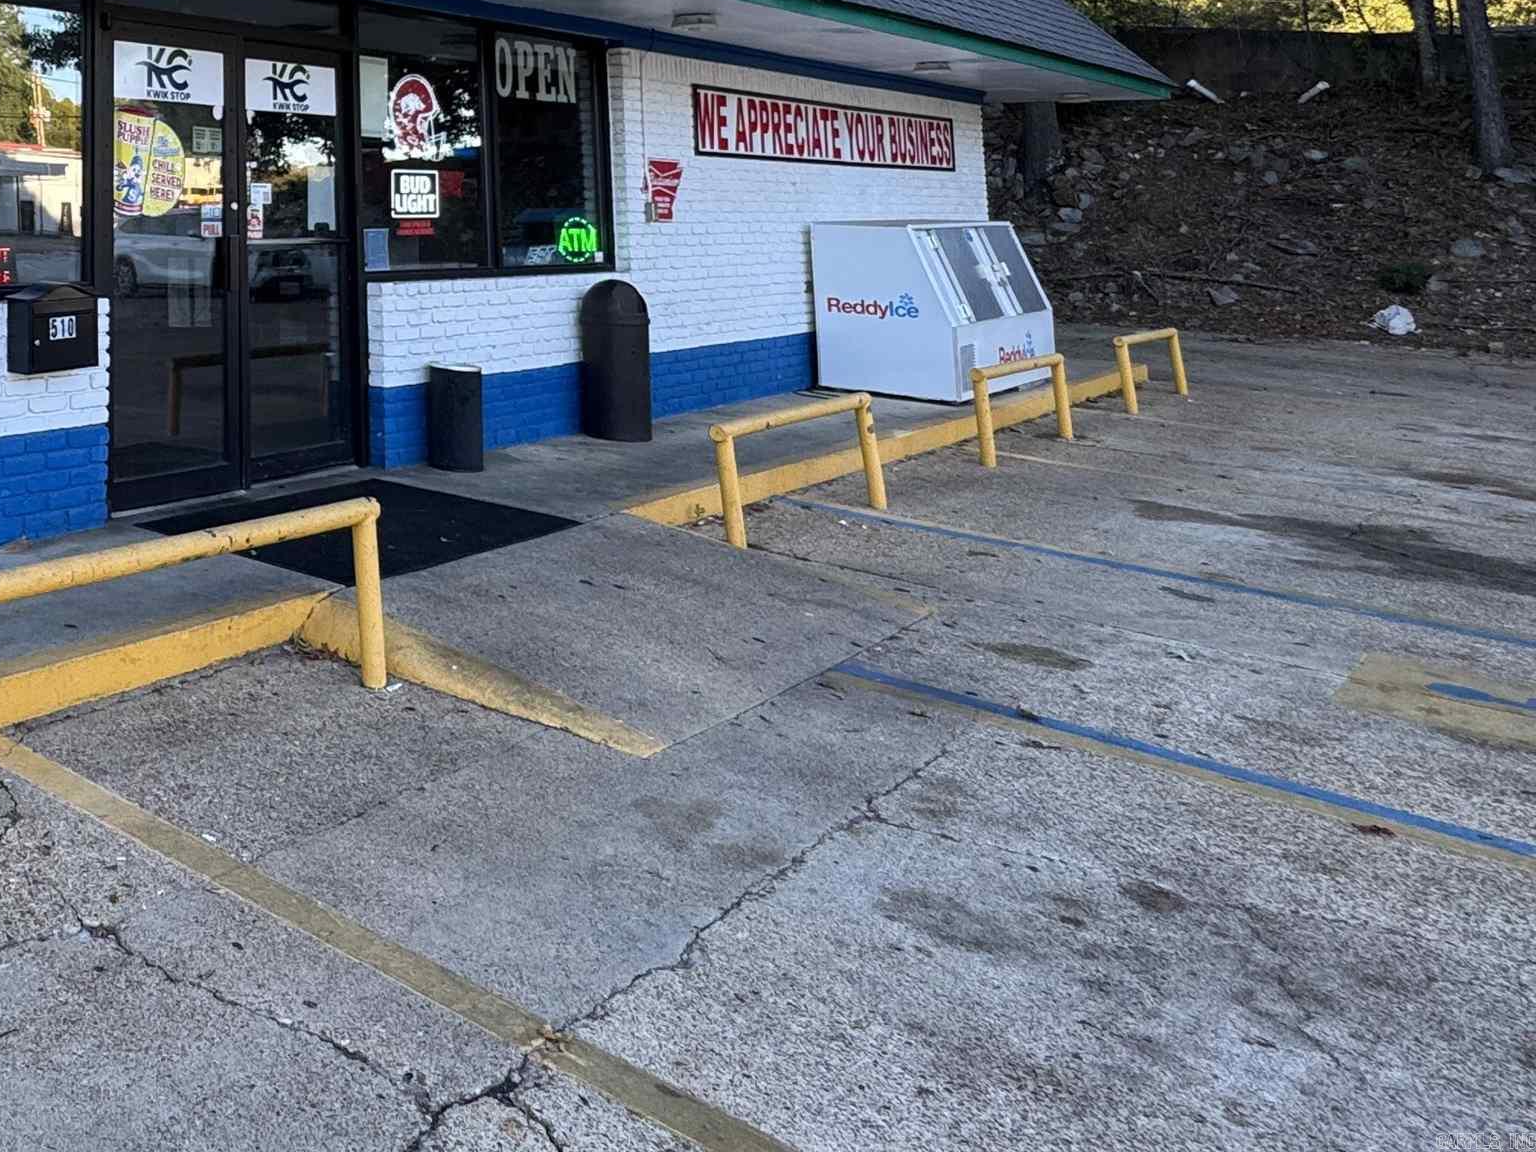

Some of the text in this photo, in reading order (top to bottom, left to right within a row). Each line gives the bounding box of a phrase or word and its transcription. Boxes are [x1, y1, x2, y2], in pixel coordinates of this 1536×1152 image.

[495, 38, 577, 104] OPEN
[146, 89, 192, 101] KWIK STOP
[272, 102, 310, 112] KWIK STOP
[118, 120, 150, 136] SLUSH
[696, 92, 952, 167] WE APPRECIATE YOUR BUSINESS
[151, 173, 182, 188] SERVED
[399, 175, 432, 194] BUD
[394, 193, 437, 213] LIGHT
[558, 227, 597, 252] ATM
[51, 317, 74, 338] 510
